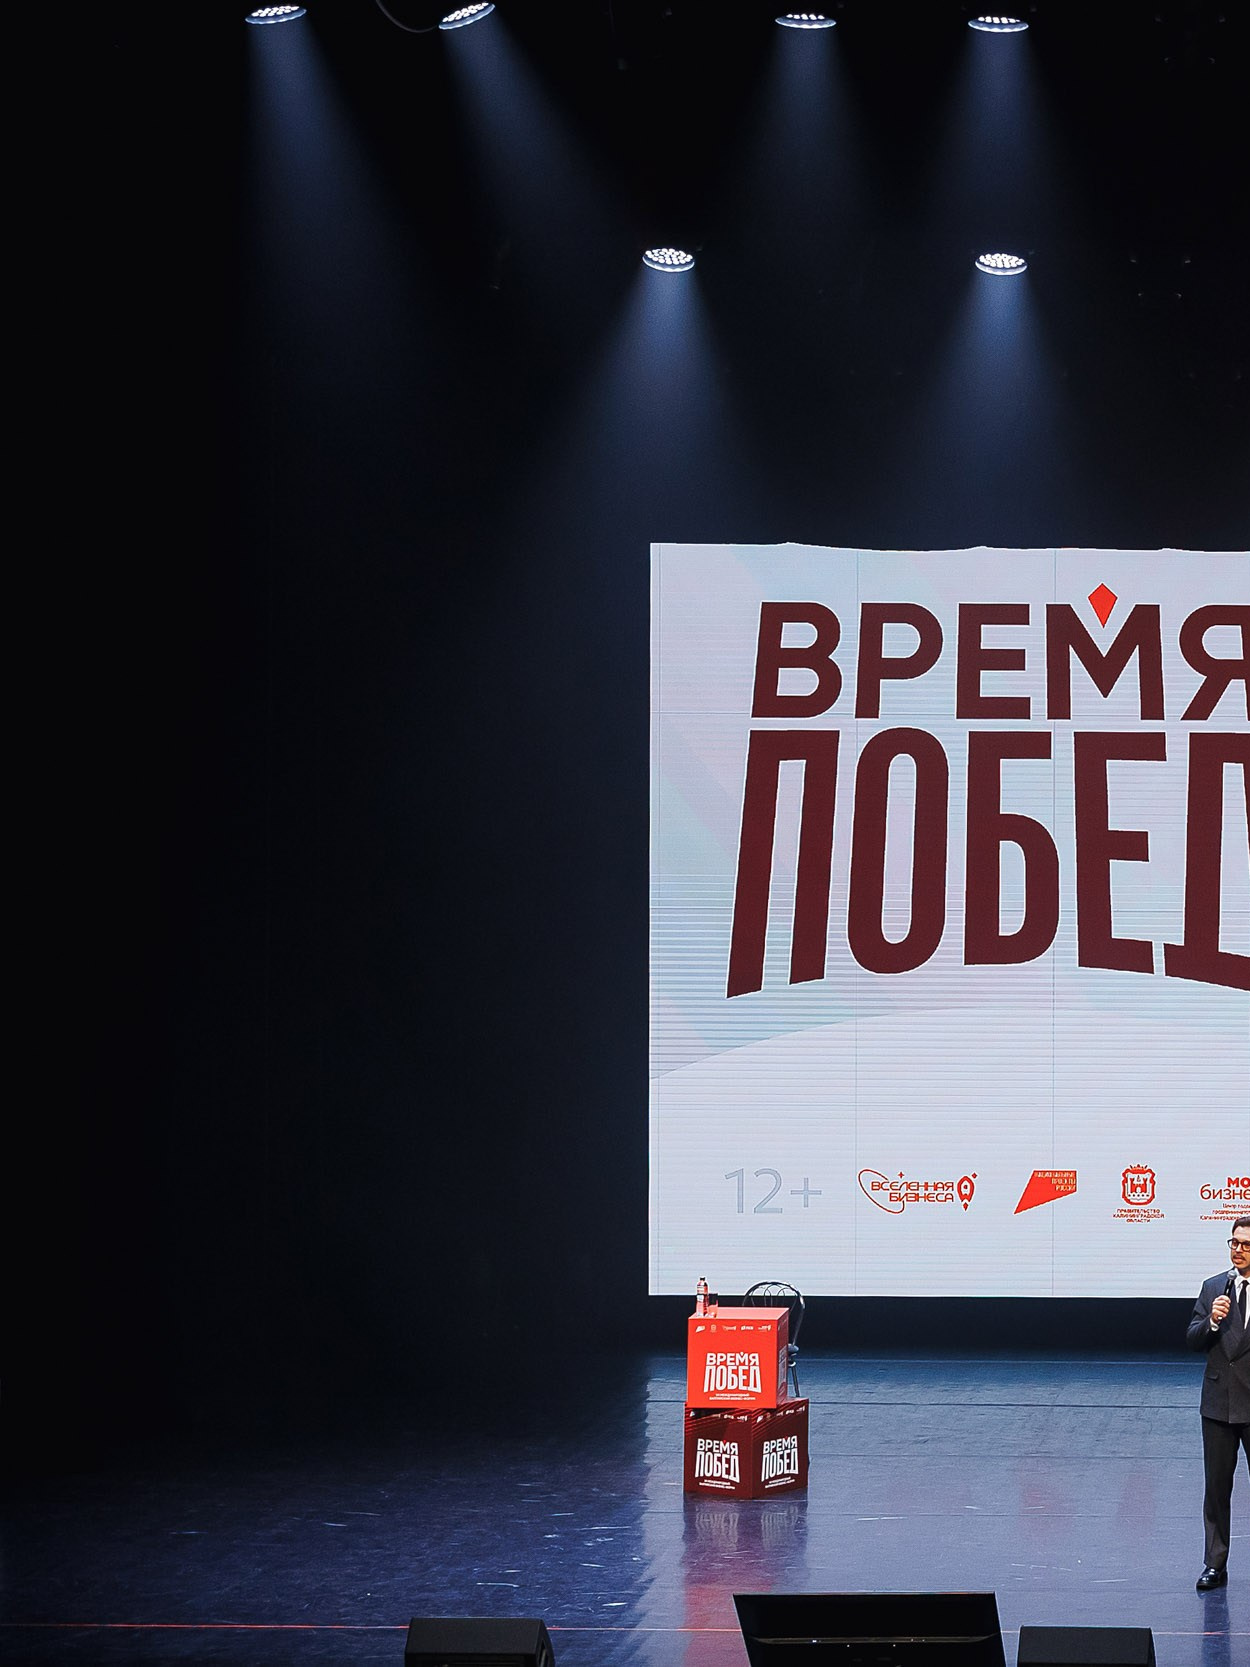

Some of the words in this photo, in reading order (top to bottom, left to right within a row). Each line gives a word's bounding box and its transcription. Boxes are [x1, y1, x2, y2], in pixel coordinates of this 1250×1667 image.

[724, 1168, 822, 1214] 12+
[871, 1181, 954, 1191] ВСЕЛЕННАЯ
[889, 1192, 954, 1202] БИЗНЕСА
[706, 1353, 759, 1365] ВРЕМЯ
[703, 1365, 761, 1393] ПОБЕД
[697, 1438, 738, 1455] ВРЕМЯ
[763, 1435, 798, 1454] ВРЕМЯ
[695, 1450, 740, 1483] ПОБЕД
[761, 1447, 799, 1482] ПОБЕД
